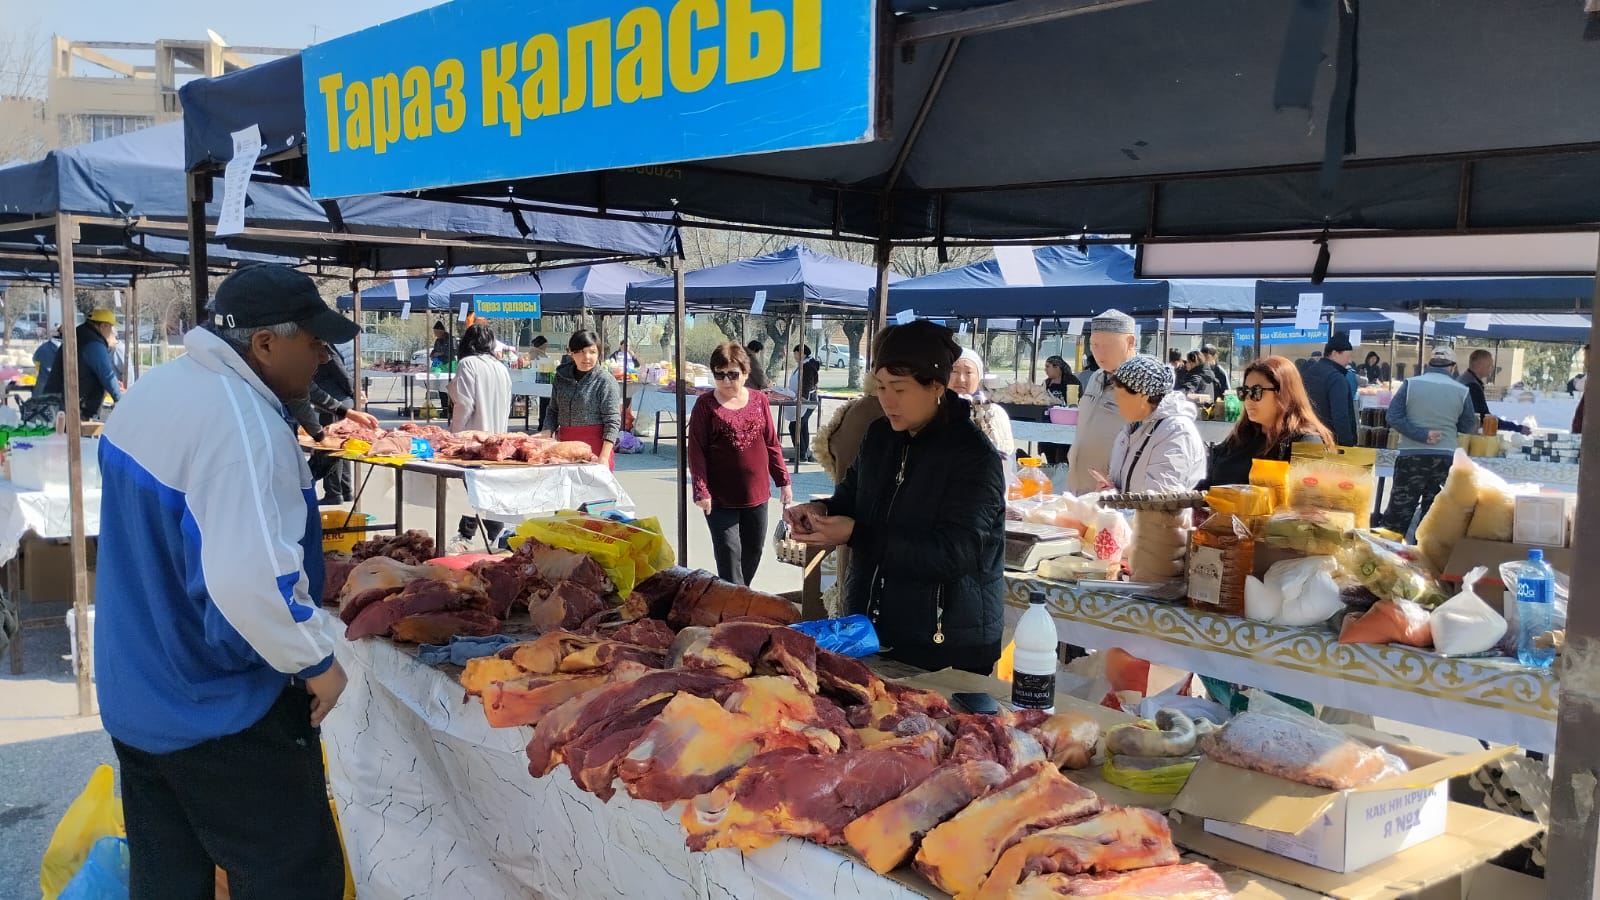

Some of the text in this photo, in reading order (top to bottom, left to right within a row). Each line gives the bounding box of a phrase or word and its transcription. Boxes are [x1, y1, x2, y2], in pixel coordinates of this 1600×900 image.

[319, 0, 823, 155] Тараз қаласы
[476, 299, 537, 313] Тараз қаласы
[1366, 803, 1386, 821] КАК
[1388, 797, 1402, 813] НИ
[1383, 820, 1393, 839] Я
